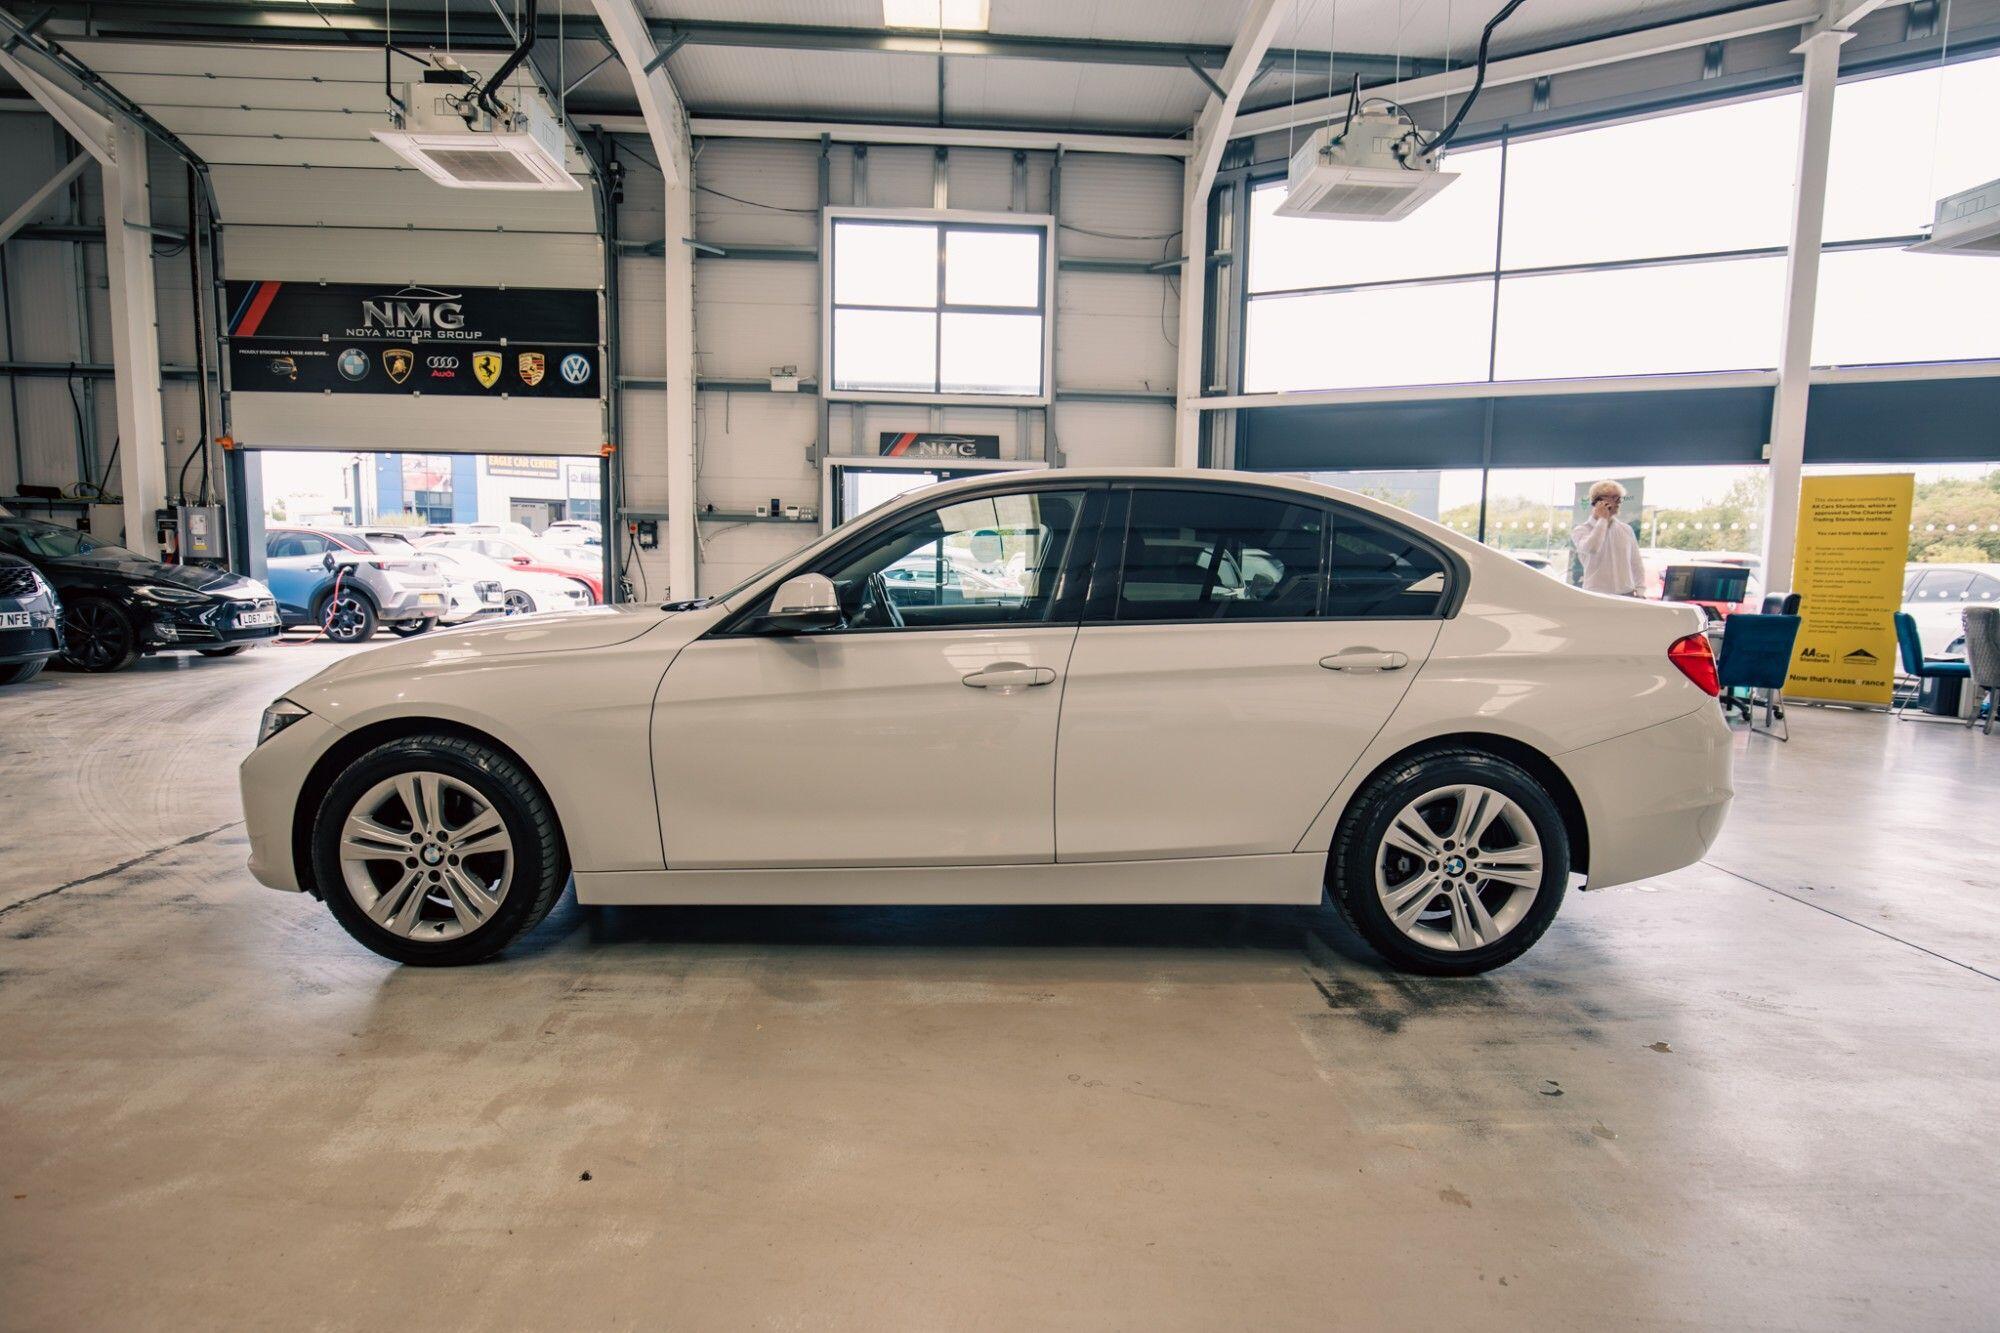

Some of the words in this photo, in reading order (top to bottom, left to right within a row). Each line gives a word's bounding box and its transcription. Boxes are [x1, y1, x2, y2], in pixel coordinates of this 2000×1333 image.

[361, 300, 465, 330] NMG
[346, 328, 380, 337] NOYA
[386, 329, 432, 338] MOTOR
[437, 330, 483, 339] GROUP
[431, 370, 455, 378] Audi
[918, 441, 976, 456] NMG
[7, 614, 29, 626] NFE
[1801, 648, 1816, 656] AA
[1790, 674, 1808, 682] Now
[1810, 675, 1832, 683] that's
